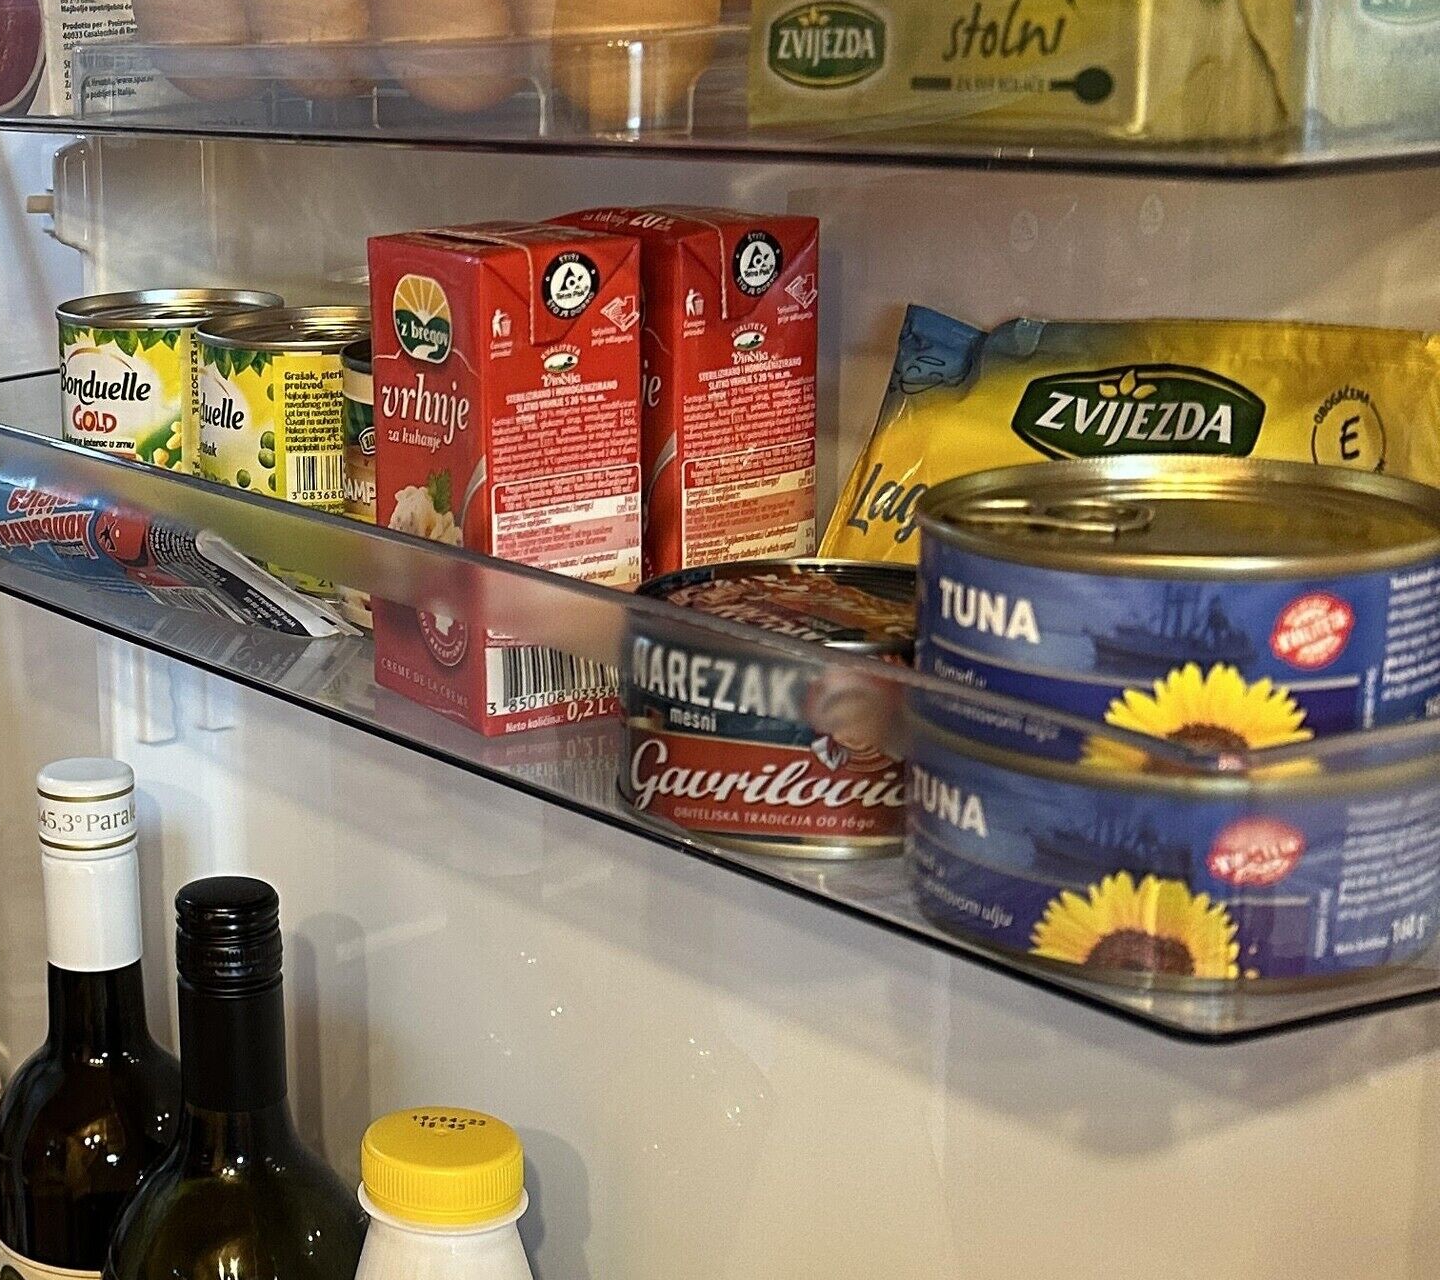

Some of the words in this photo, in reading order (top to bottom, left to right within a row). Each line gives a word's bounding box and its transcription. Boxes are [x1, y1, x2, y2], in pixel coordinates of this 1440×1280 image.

[777, 22, 877, 63] ZVIJEZDA
[410, 321, 450, 351] bregov
[61, 362, 152, 406] Bonduelle
[284, 371, 319, 381] Grašak,
[284, 381, 324, 391] proizvod
[72, 403, 118, 434] GOLD
[381, 375, 471, 446] vrhnje
[1035, 389, 1234, 447] ZVIJEZDA
[115, 438, 135, 450] zrnu
[386, 428, 401, 443] za
[401, 426, 443, 451] kuhanje
[1339, 414, 1361, 461] E
[939, 578, 1042, 645] TUNA
[631, 636, 806, 721] NAREZAK
[487, 702, 498, 716] 3
[508, 689, 566, 714] 850108
[566, 699, 594, 723] 0,2
[505, 719, 527, 734] Neto
[669, 708, 718, 732] mesni
[911, 765, 987, 838] TUNA
[743, 811, 811, 827] TRADICIJA
[815, 812, 838, 827] OD
